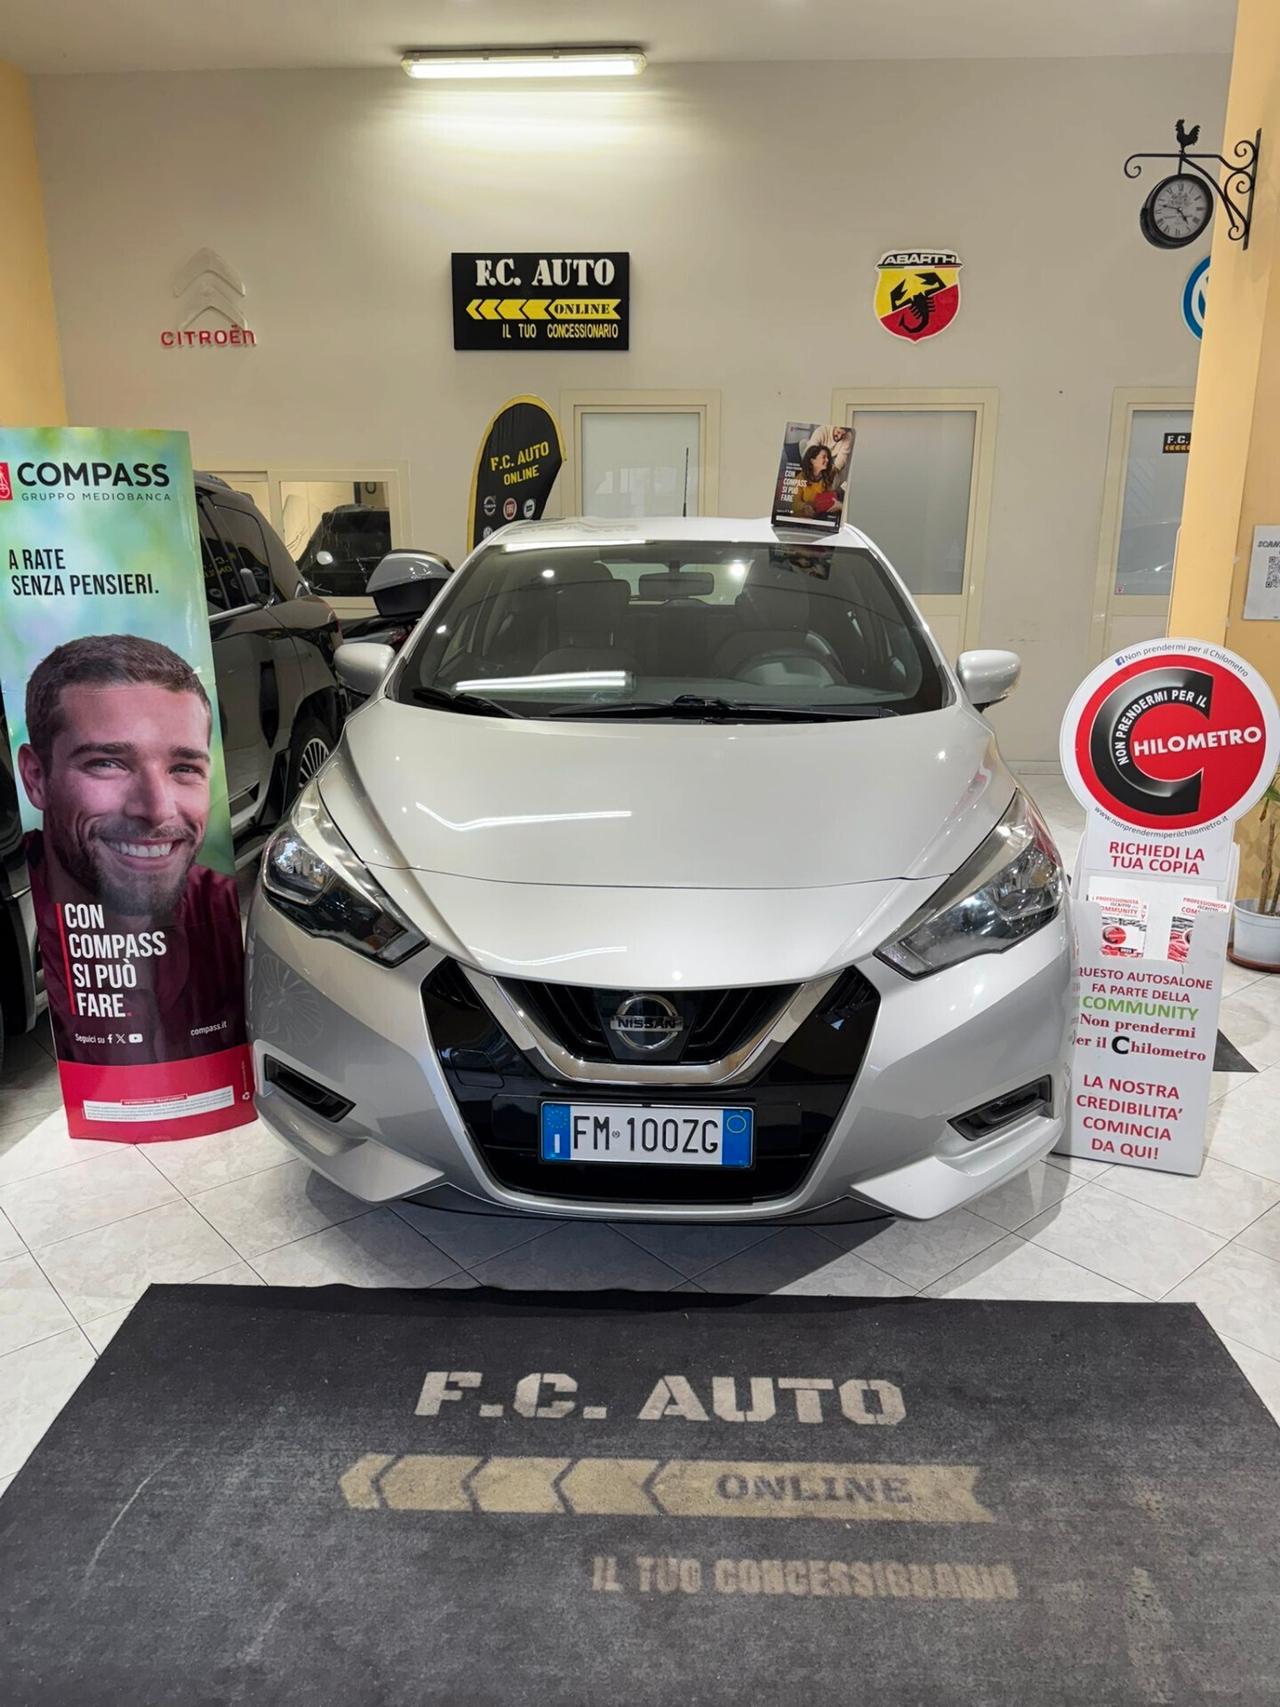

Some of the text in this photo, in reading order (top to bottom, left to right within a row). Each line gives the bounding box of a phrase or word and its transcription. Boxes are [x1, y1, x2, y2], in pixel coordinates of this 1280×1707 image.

[884, 253, 955, 264] ABARTH
[531, 258, 615, 286] AUTO
[554, 303, 610, 315] ONLINE
[502, 323, 618, 339] IL TUO CONCESSIONARIO
[490, 441, 550, 472] F.C. AUTO
[17, 461, 170, 488] COMPASS
[503, 465, 540, 486] ONLINE
[21, 492, 171, 502] GRUPPO MEDIOBANCA
[9, 549, 66, 571] A RATE
[12, 573, 159, 596] SENZA PENSIERI.
[1124, 643, 1249, 678] Non prendermi per il Chilometro
[1114, 689, 1208, 766] NON PRENDERMI PER IL
[1109, 842, 1205, 861] RICHIEDI LA
[1111, 855, 1200, 875] TUA COPIA
[64, 903, 105, 929] CON
[68, 931, 167, 959] COMPASS
[73, 959, 137, 988] SI PUÒ
[1127, 972, 1213, 990] AUTOSALONE
[1092, 983, 1191, 1003] FA PARTE DELLA
[1082, 995, 1199, 1021] COMMUNITY
[190, 1021, 227, 1036] compass.it
[617, 1018, 677, 1029] NISSAN
[1080, 1013, 1196, 1038] Non prendermi
[75, 1033, 96, 1044] Seguici
[1096, 1036, 1107, 1049] il
[1111, 1035, 1206, 1062] Chilometro
[1083, 1074, 1180, 1100] LA NOSTRA
[1083, 1116, 1172, 1141] COMINCIA
[1091, 1138, 1159, 1160] DA QUI!
[414, 1371, 907, 1425] F.C. AUTO
[716, 1473, 913, 1504] ONLINE
[592, 1556, 1019, 1600] IL TUO CONCESSIONARIO
